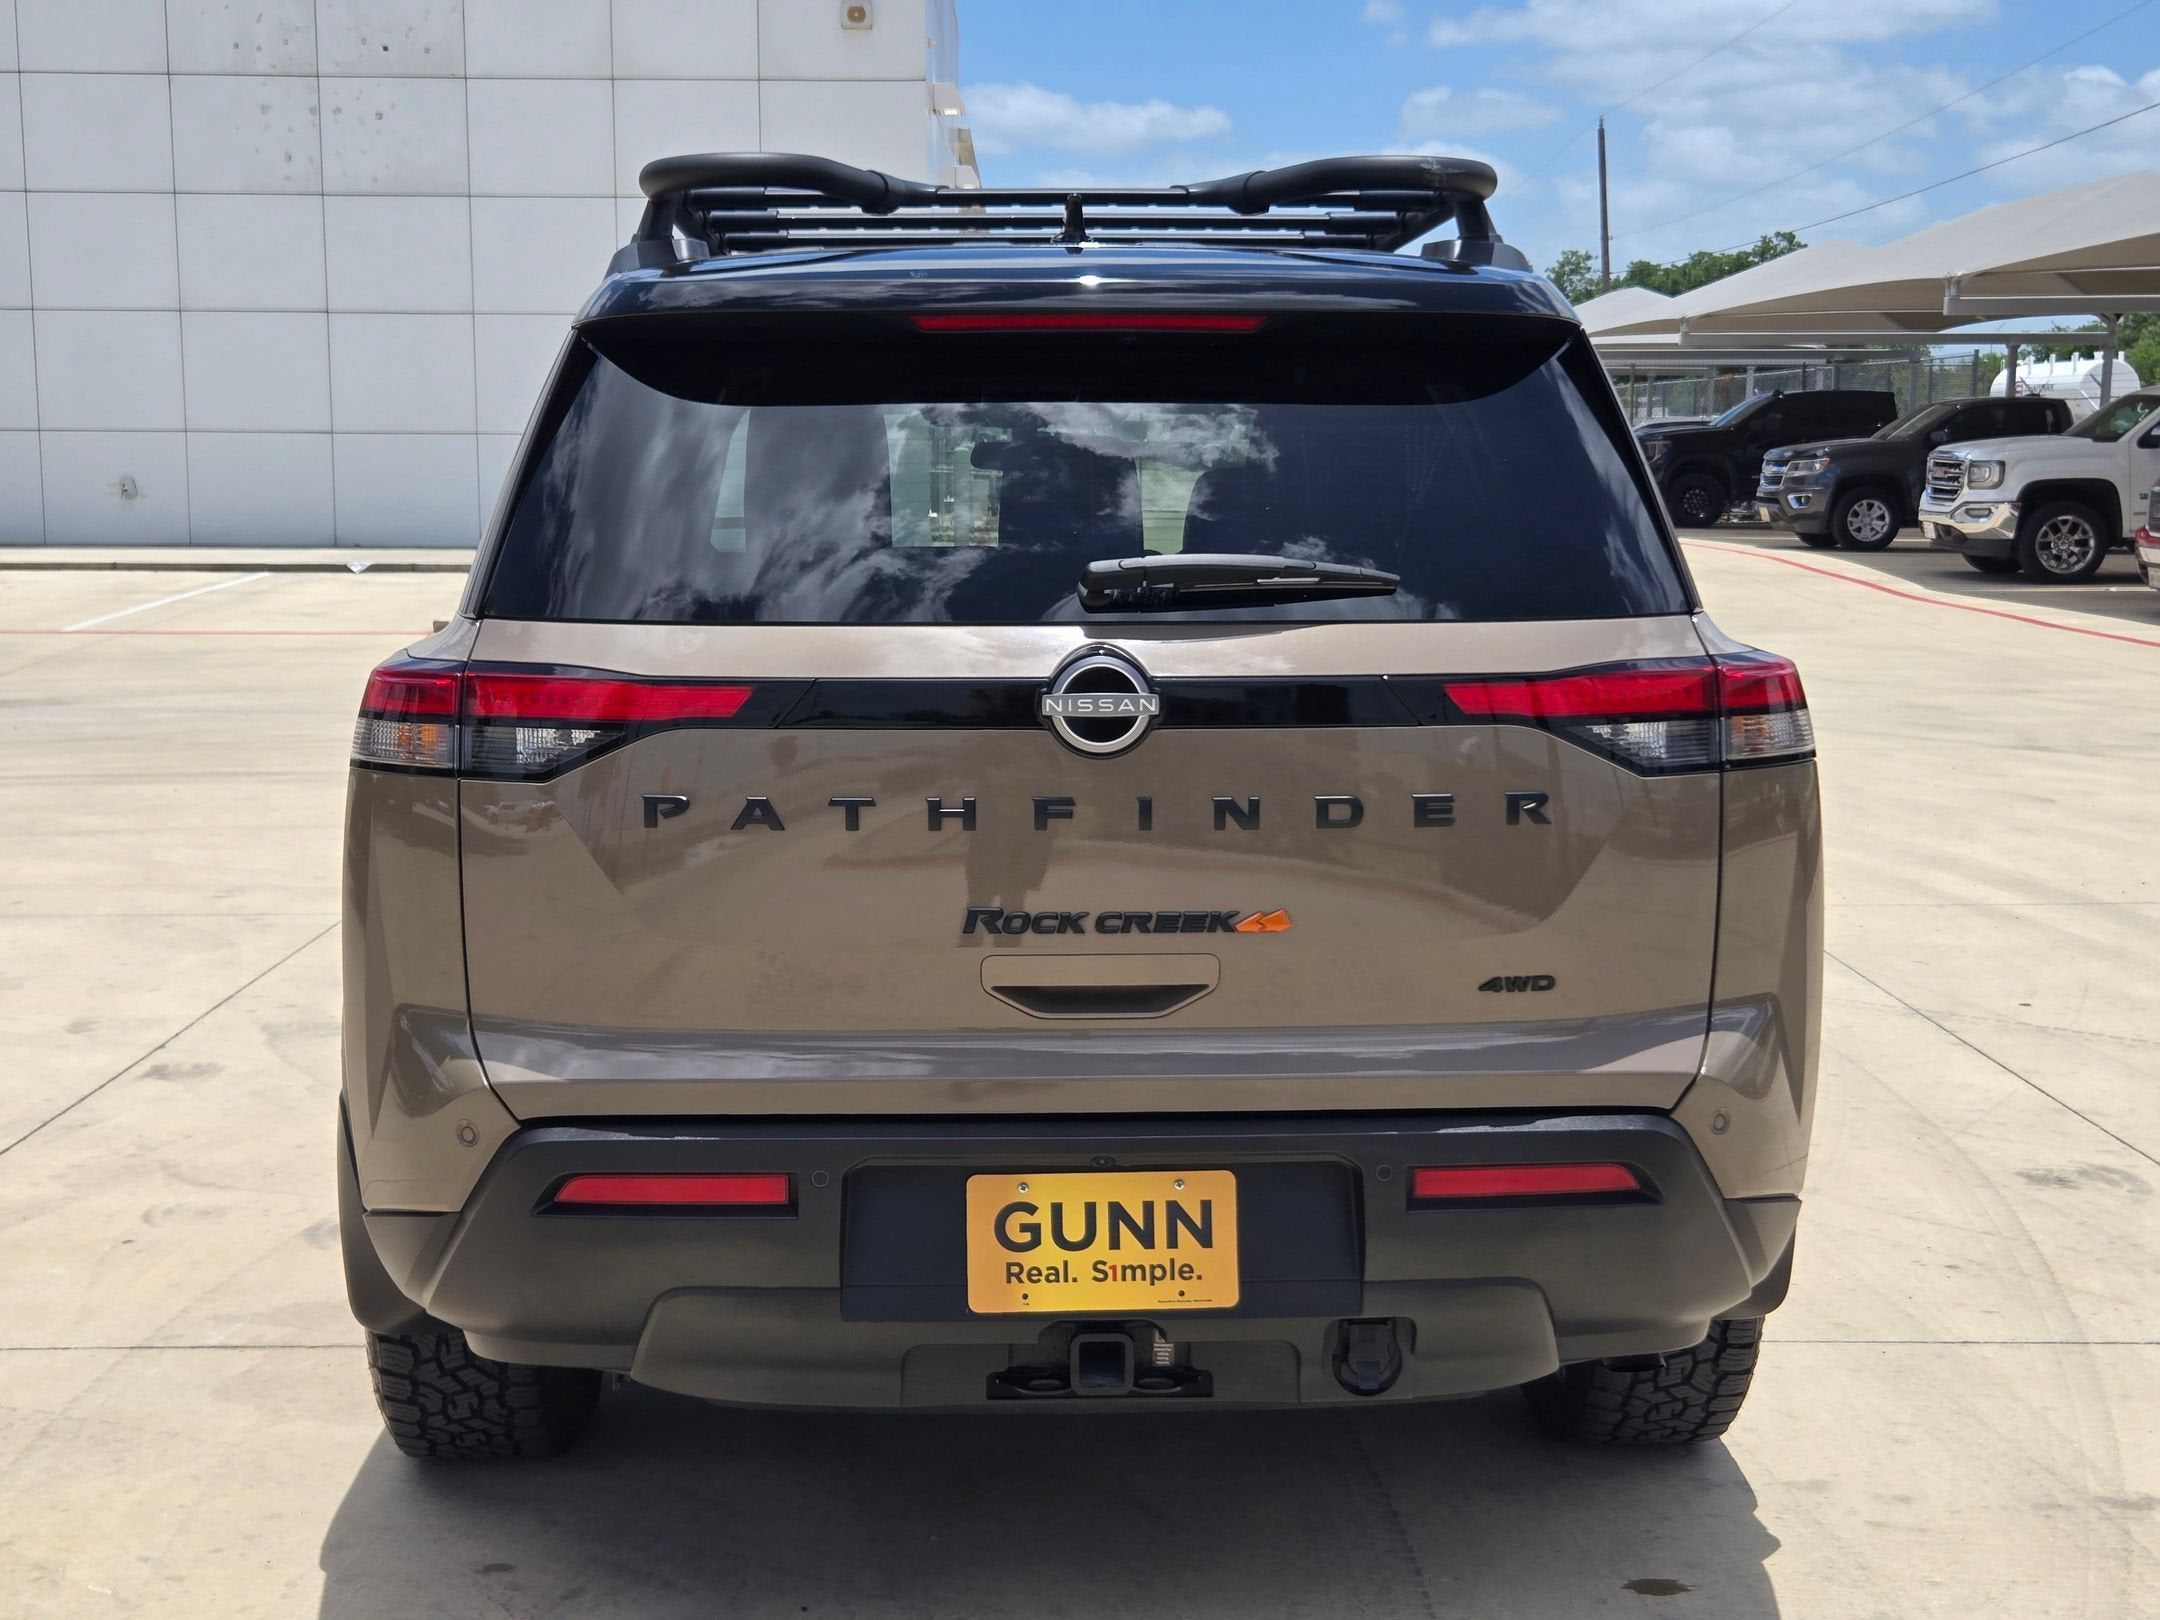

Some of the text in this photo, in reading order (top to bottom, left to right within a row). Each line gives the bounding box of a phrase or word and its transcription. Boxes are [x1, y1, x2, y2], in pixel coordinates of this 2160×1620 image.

[1045, 698, 1156, 712] NISSAN
[641, 791, 1553, 832] PATHFINDER
[1095, 909, 1240, 934] CREEK
[1478, 974, 1556, 993] 4WD
[994, 1199, 1214, 1253] GUNN
[1005, 1259, 1078, 1284] Real.
